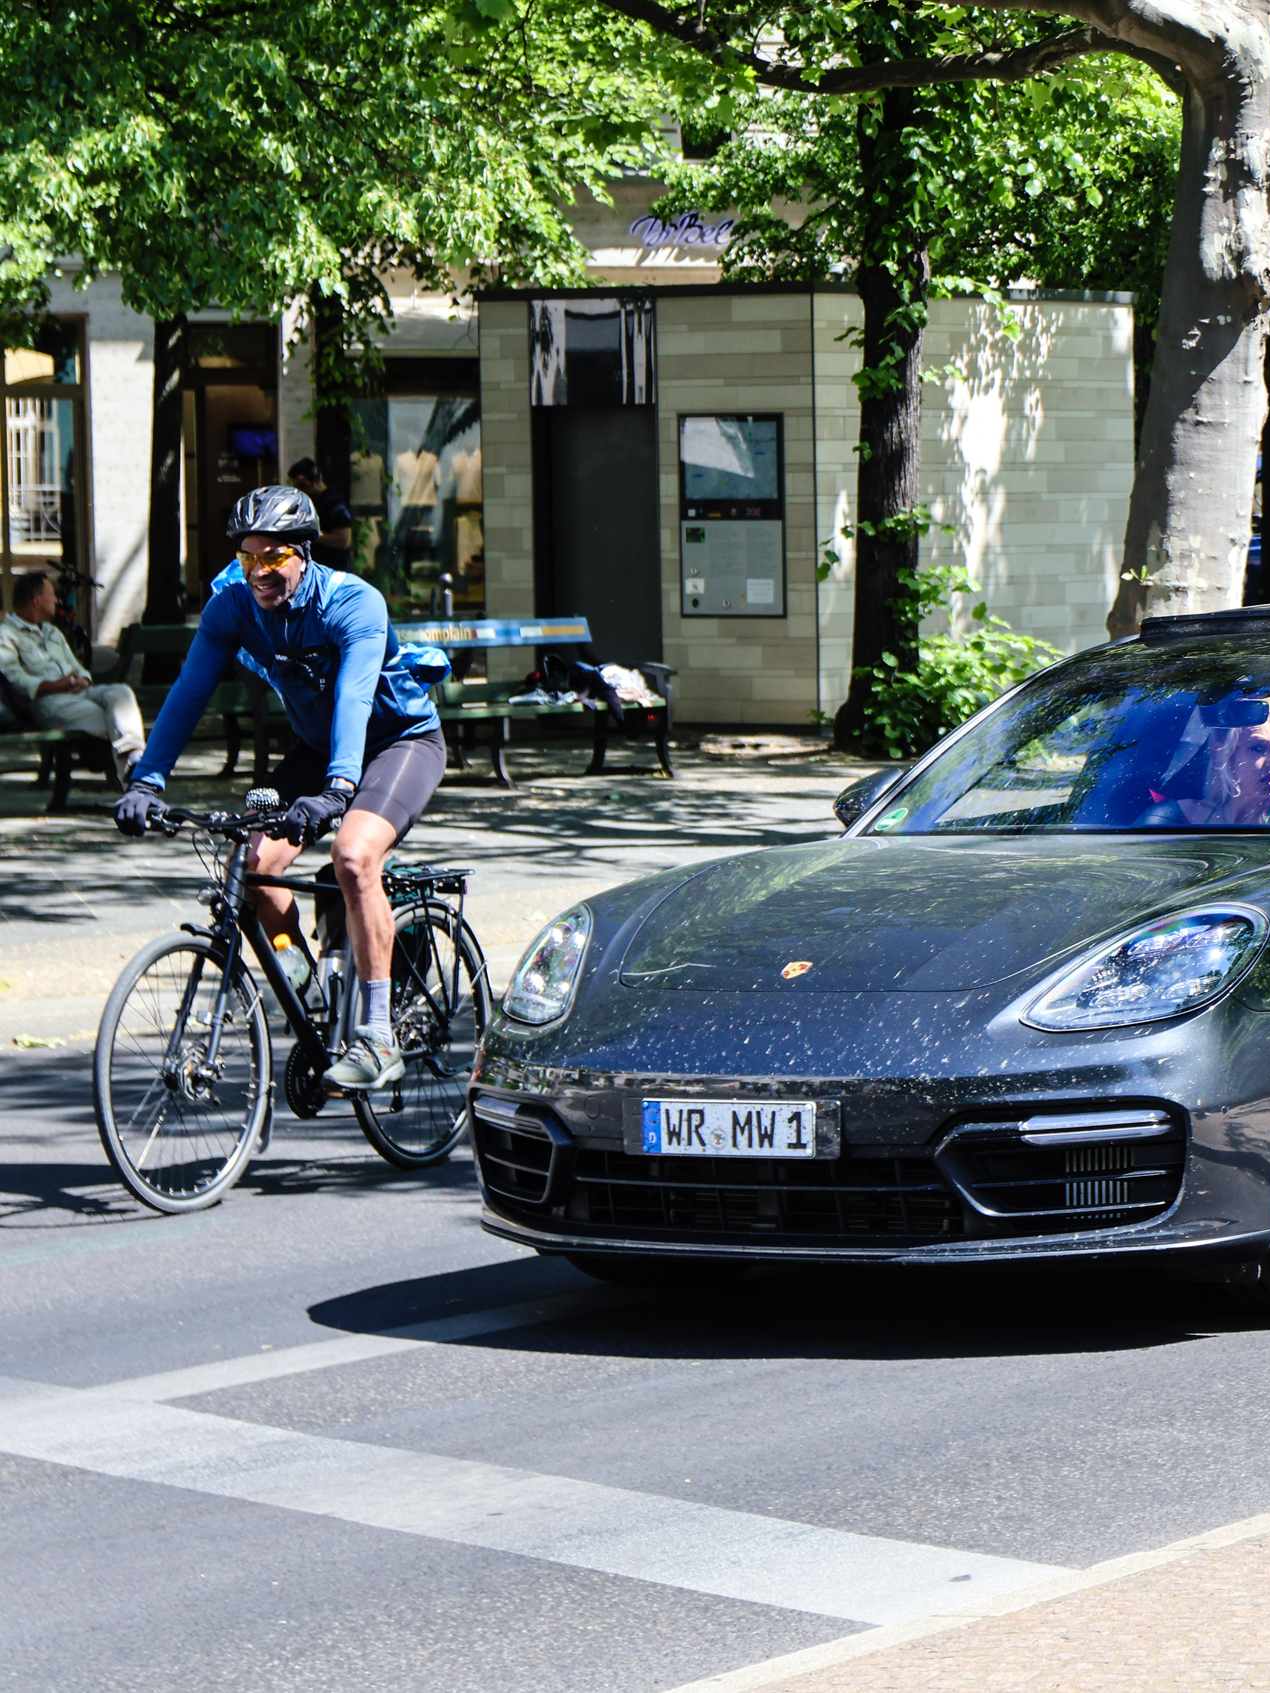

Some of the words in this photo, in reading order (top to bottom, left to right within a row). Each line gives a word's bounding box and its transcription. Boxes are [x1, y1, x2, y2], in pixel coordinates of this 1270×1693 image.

[664, 1108, 706, 1147] WR
[731, 1110, 775, 1149] MW
[787, 1111, 807, 1150] 1
